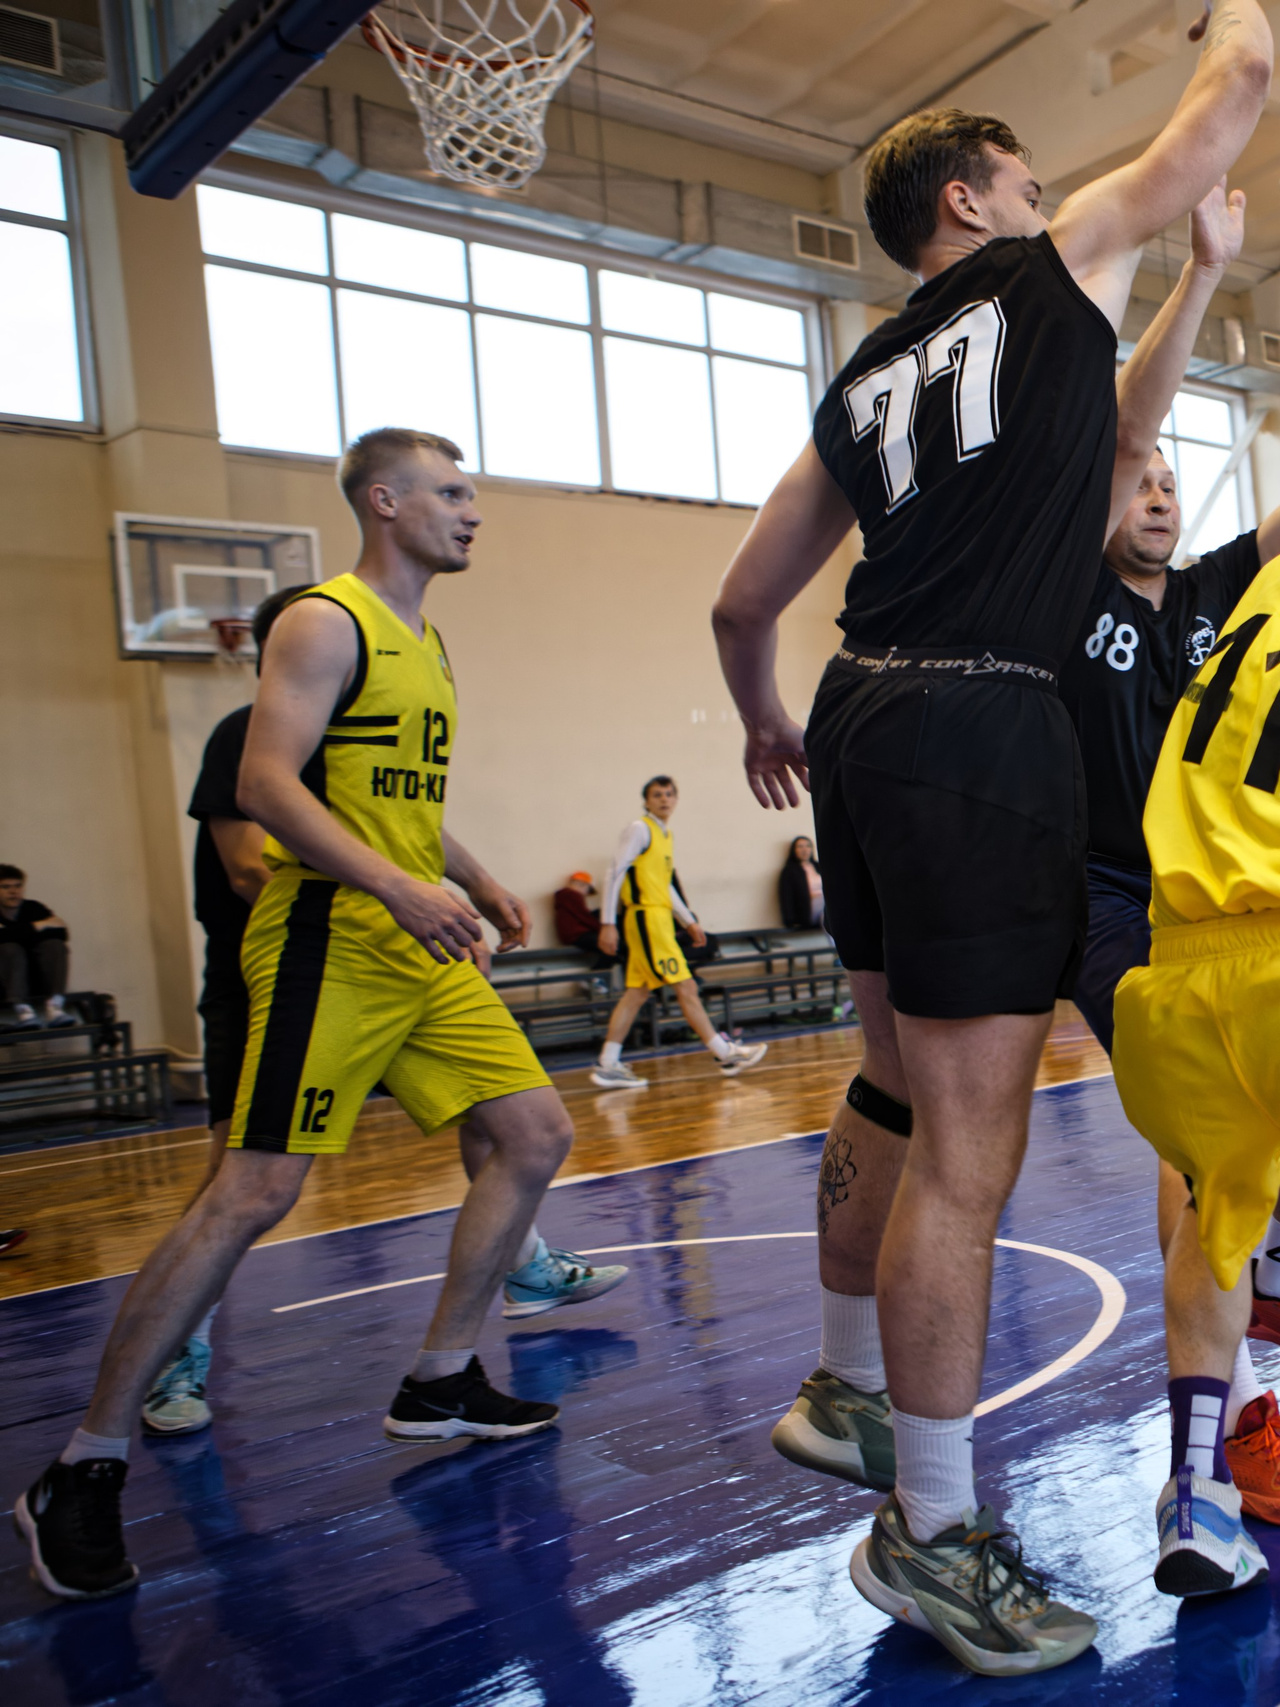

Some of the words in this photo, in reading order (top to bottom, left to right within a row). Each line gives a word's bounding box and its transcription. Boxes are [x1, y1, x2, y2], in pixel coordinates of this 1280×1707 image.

[843, 297, 1007, 515] 77
[1085, 612, 1139, 672] 88
[422, 707, 450, 766] 12
[658, 957, 679, 976] 10
[299, 1087, 335, 1133] 12
